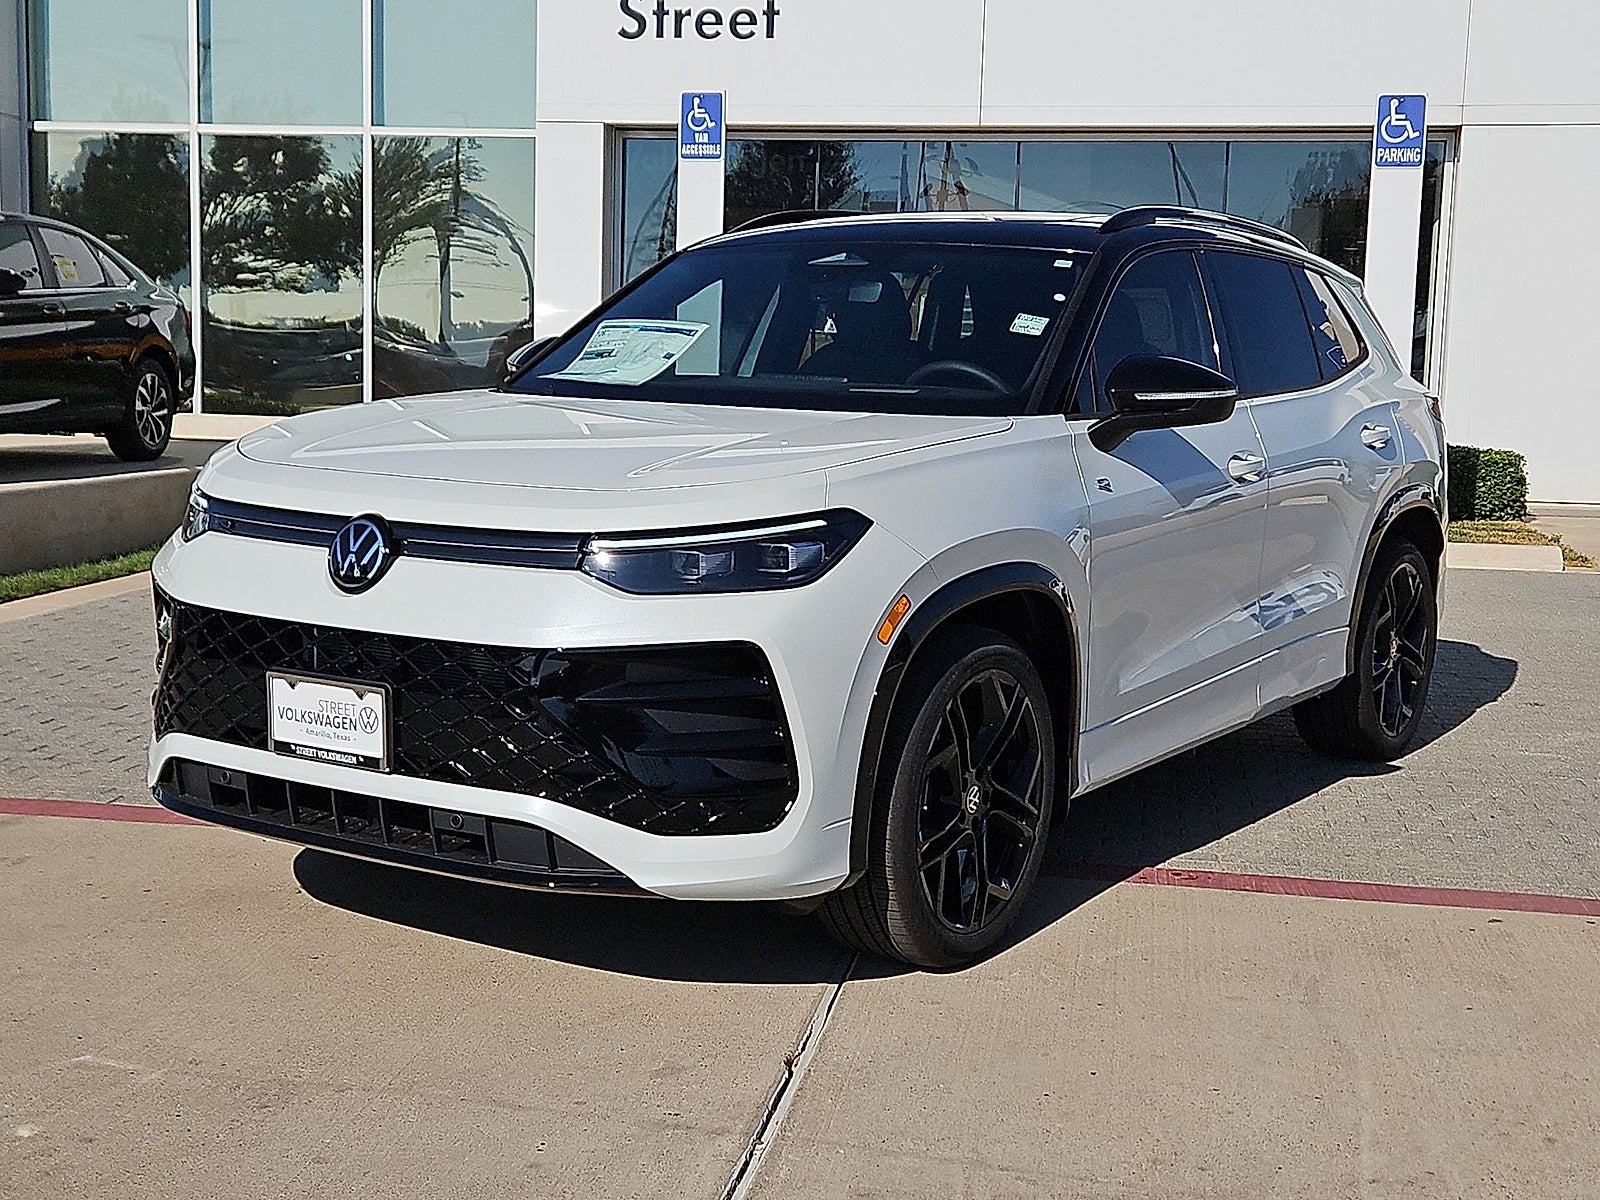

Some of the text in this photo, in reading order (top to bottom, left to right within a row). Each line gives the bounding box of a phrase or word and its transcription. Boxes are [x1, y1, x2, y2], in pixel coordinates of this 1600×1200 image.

[617, 0, 781, 40] Street
[694, 131, 710, 144] VAN
[681, 143, 721, 156] ACCESSIBLE
[1376, 147, 1421, 163] PARKING
[330, 519, 384, 588] VW
[318, 699, 357, 718] STREET
[277, 705, 358, 732] VOLKSWAGEN
[359, 706, 379, 735] VW
[295, 746, 317, 758] STREET
